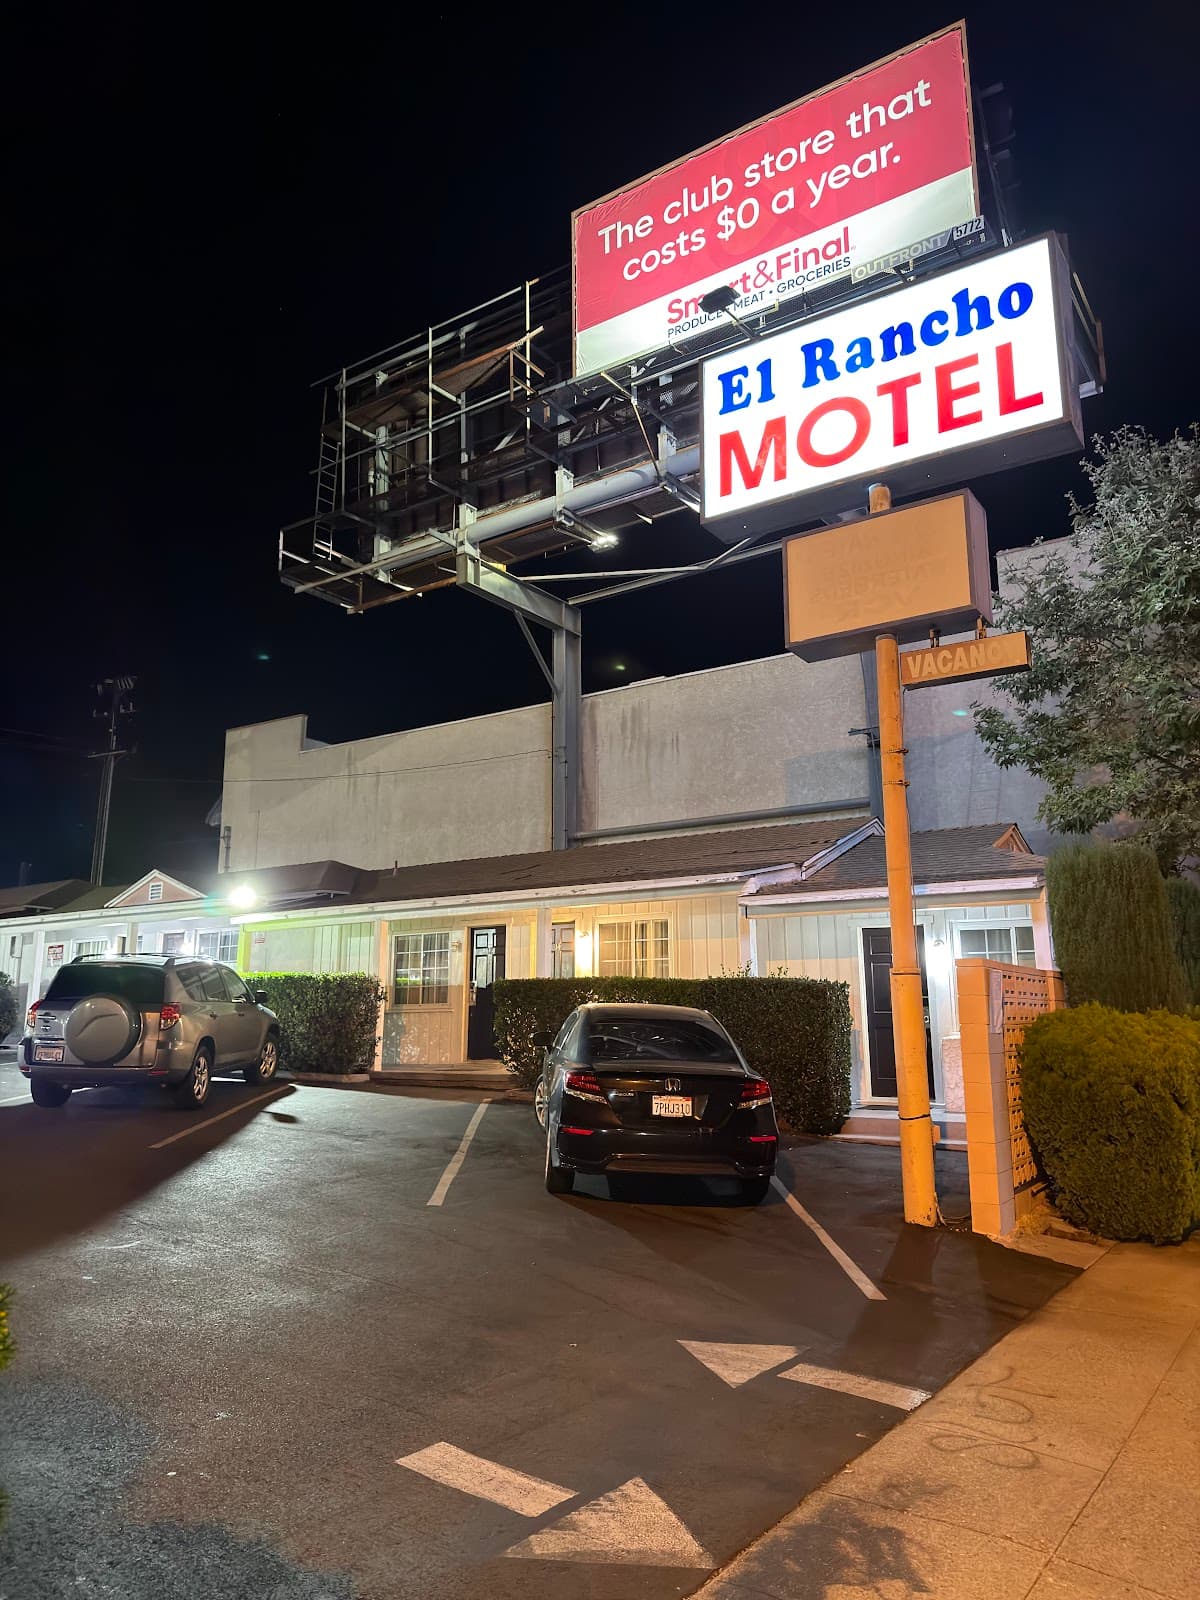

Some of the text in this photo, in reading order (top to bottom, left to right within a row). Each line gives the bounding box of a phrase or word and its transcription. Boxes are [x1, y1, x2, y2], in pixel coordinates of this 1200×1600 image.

[597, 79, 932, 254] The club store that
[622, 142, 901, 281] costs $0 a year.
[853, 231, 947, 280] OUTFRONT
[955, 218, 983, 239] 5772
[667, 226, 850, 324] Smt&Final
[667, 256, 851, 338] PRODUCE MEAT GROCERIES
[717, 281, 1034, 416] El Rancho
[719, 342, 1044, 498] MOTEL
[906, 640, 1014, 679] VACANC
[653, 1101, 691, 1116] 7PHJ310
